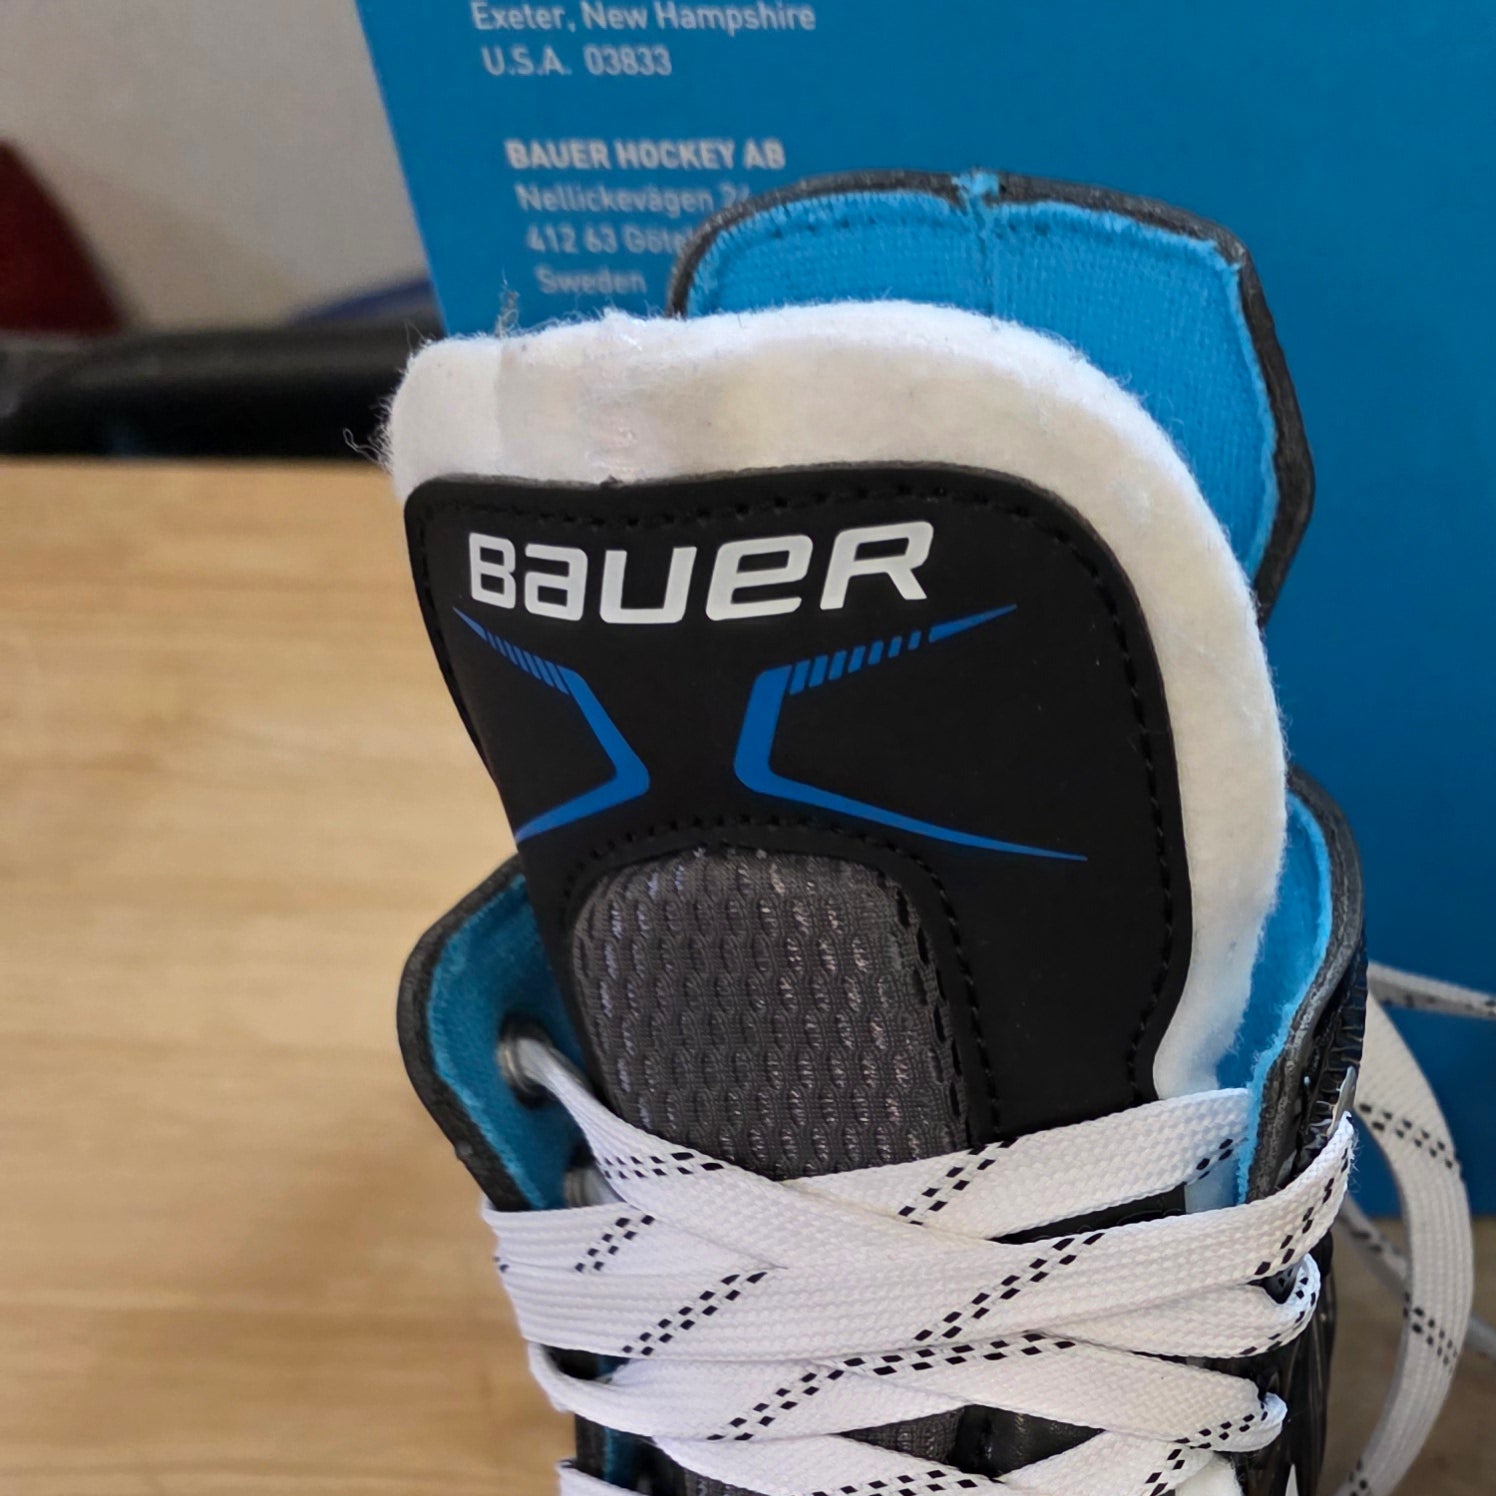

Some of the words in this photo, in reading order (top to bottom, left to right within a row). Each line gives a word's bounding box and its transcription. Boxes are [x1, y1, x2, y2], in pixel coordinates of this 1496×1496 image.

[471, 1, 576, 33] Exeter,
[581, 1, 648, 30] New
[655, 0, 817, 37] Hampshire
[481, 46, 573, 76] U.S.A.
[583, 45, 672, 76] 03833
[505, 139, 611, 169] BAUER
[614, 139, 735, 170] HOCKEY
[743, 139, 786, 169] AB
[528, 226, 578, 253] 412
[535, 265, 648, 294] Sweden
[469, 521, 934, 624] BAUER
